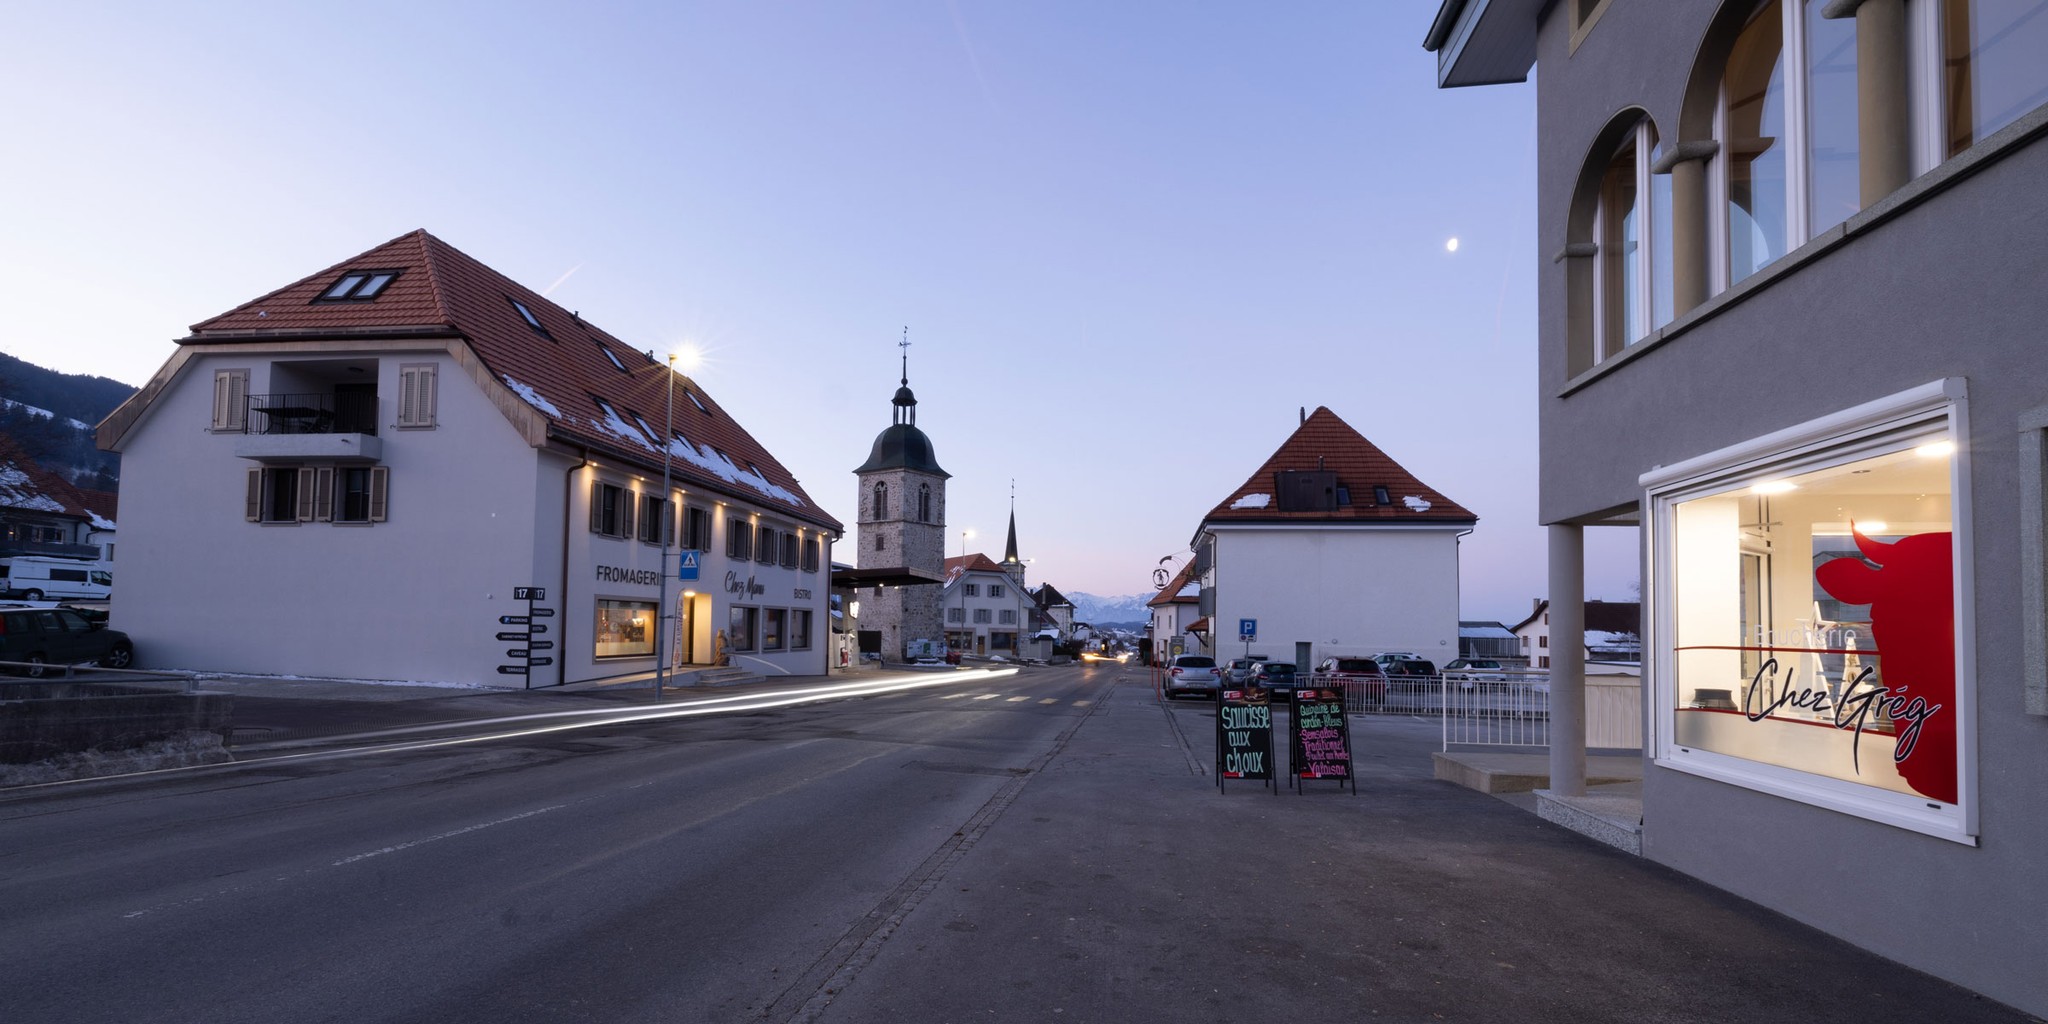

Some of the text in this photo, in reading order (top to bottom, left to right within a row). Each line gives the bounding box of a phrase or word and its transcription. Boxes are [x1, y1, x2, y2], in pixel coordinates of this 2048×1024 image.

[518, 588, 528, 598] 17
[724, 570, 745, 600] Chez
[536, 589, 544, 599] 17
[793, 588, 811, 600] BISTRO
[1244, 622, 1252, 633] P
[1754, 624, 1857, 648] Boucherie
[1330, 702, 1340, 713] de
[1221, 704, 1270, 729] Saucisse
[1746, 657, 1942, 776] Chez Grég
[1228, 731, 1251, 747] aux
[1226, 747, 1264, 773] choux
